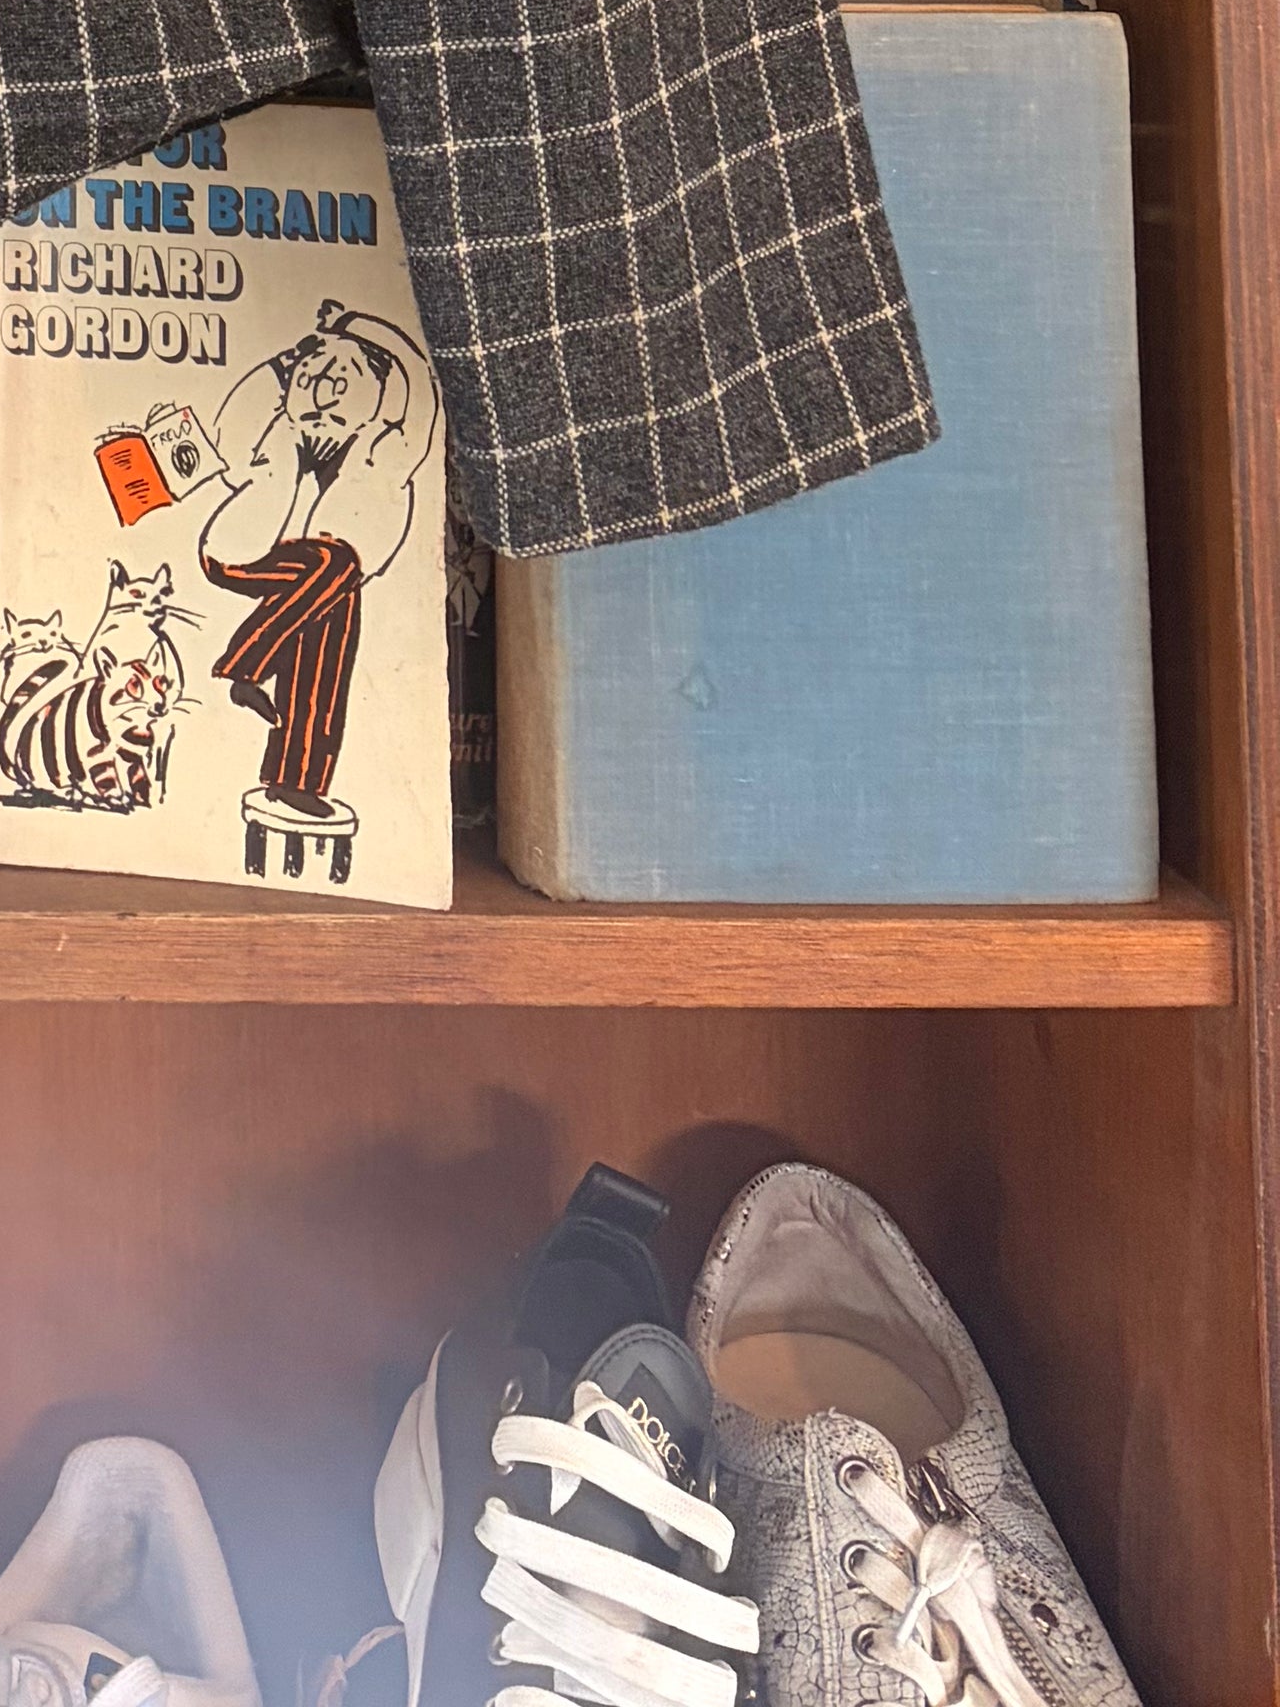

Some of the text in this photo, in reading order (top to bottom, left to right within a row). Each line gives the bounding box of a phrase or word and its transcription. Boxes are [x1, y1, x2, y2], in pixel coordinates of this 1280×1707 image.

[84, 179, 380, 247] THE BRAIN
[0, 238, 245, 305] RICHARD
[148, 416, 194, 454] FREUD
